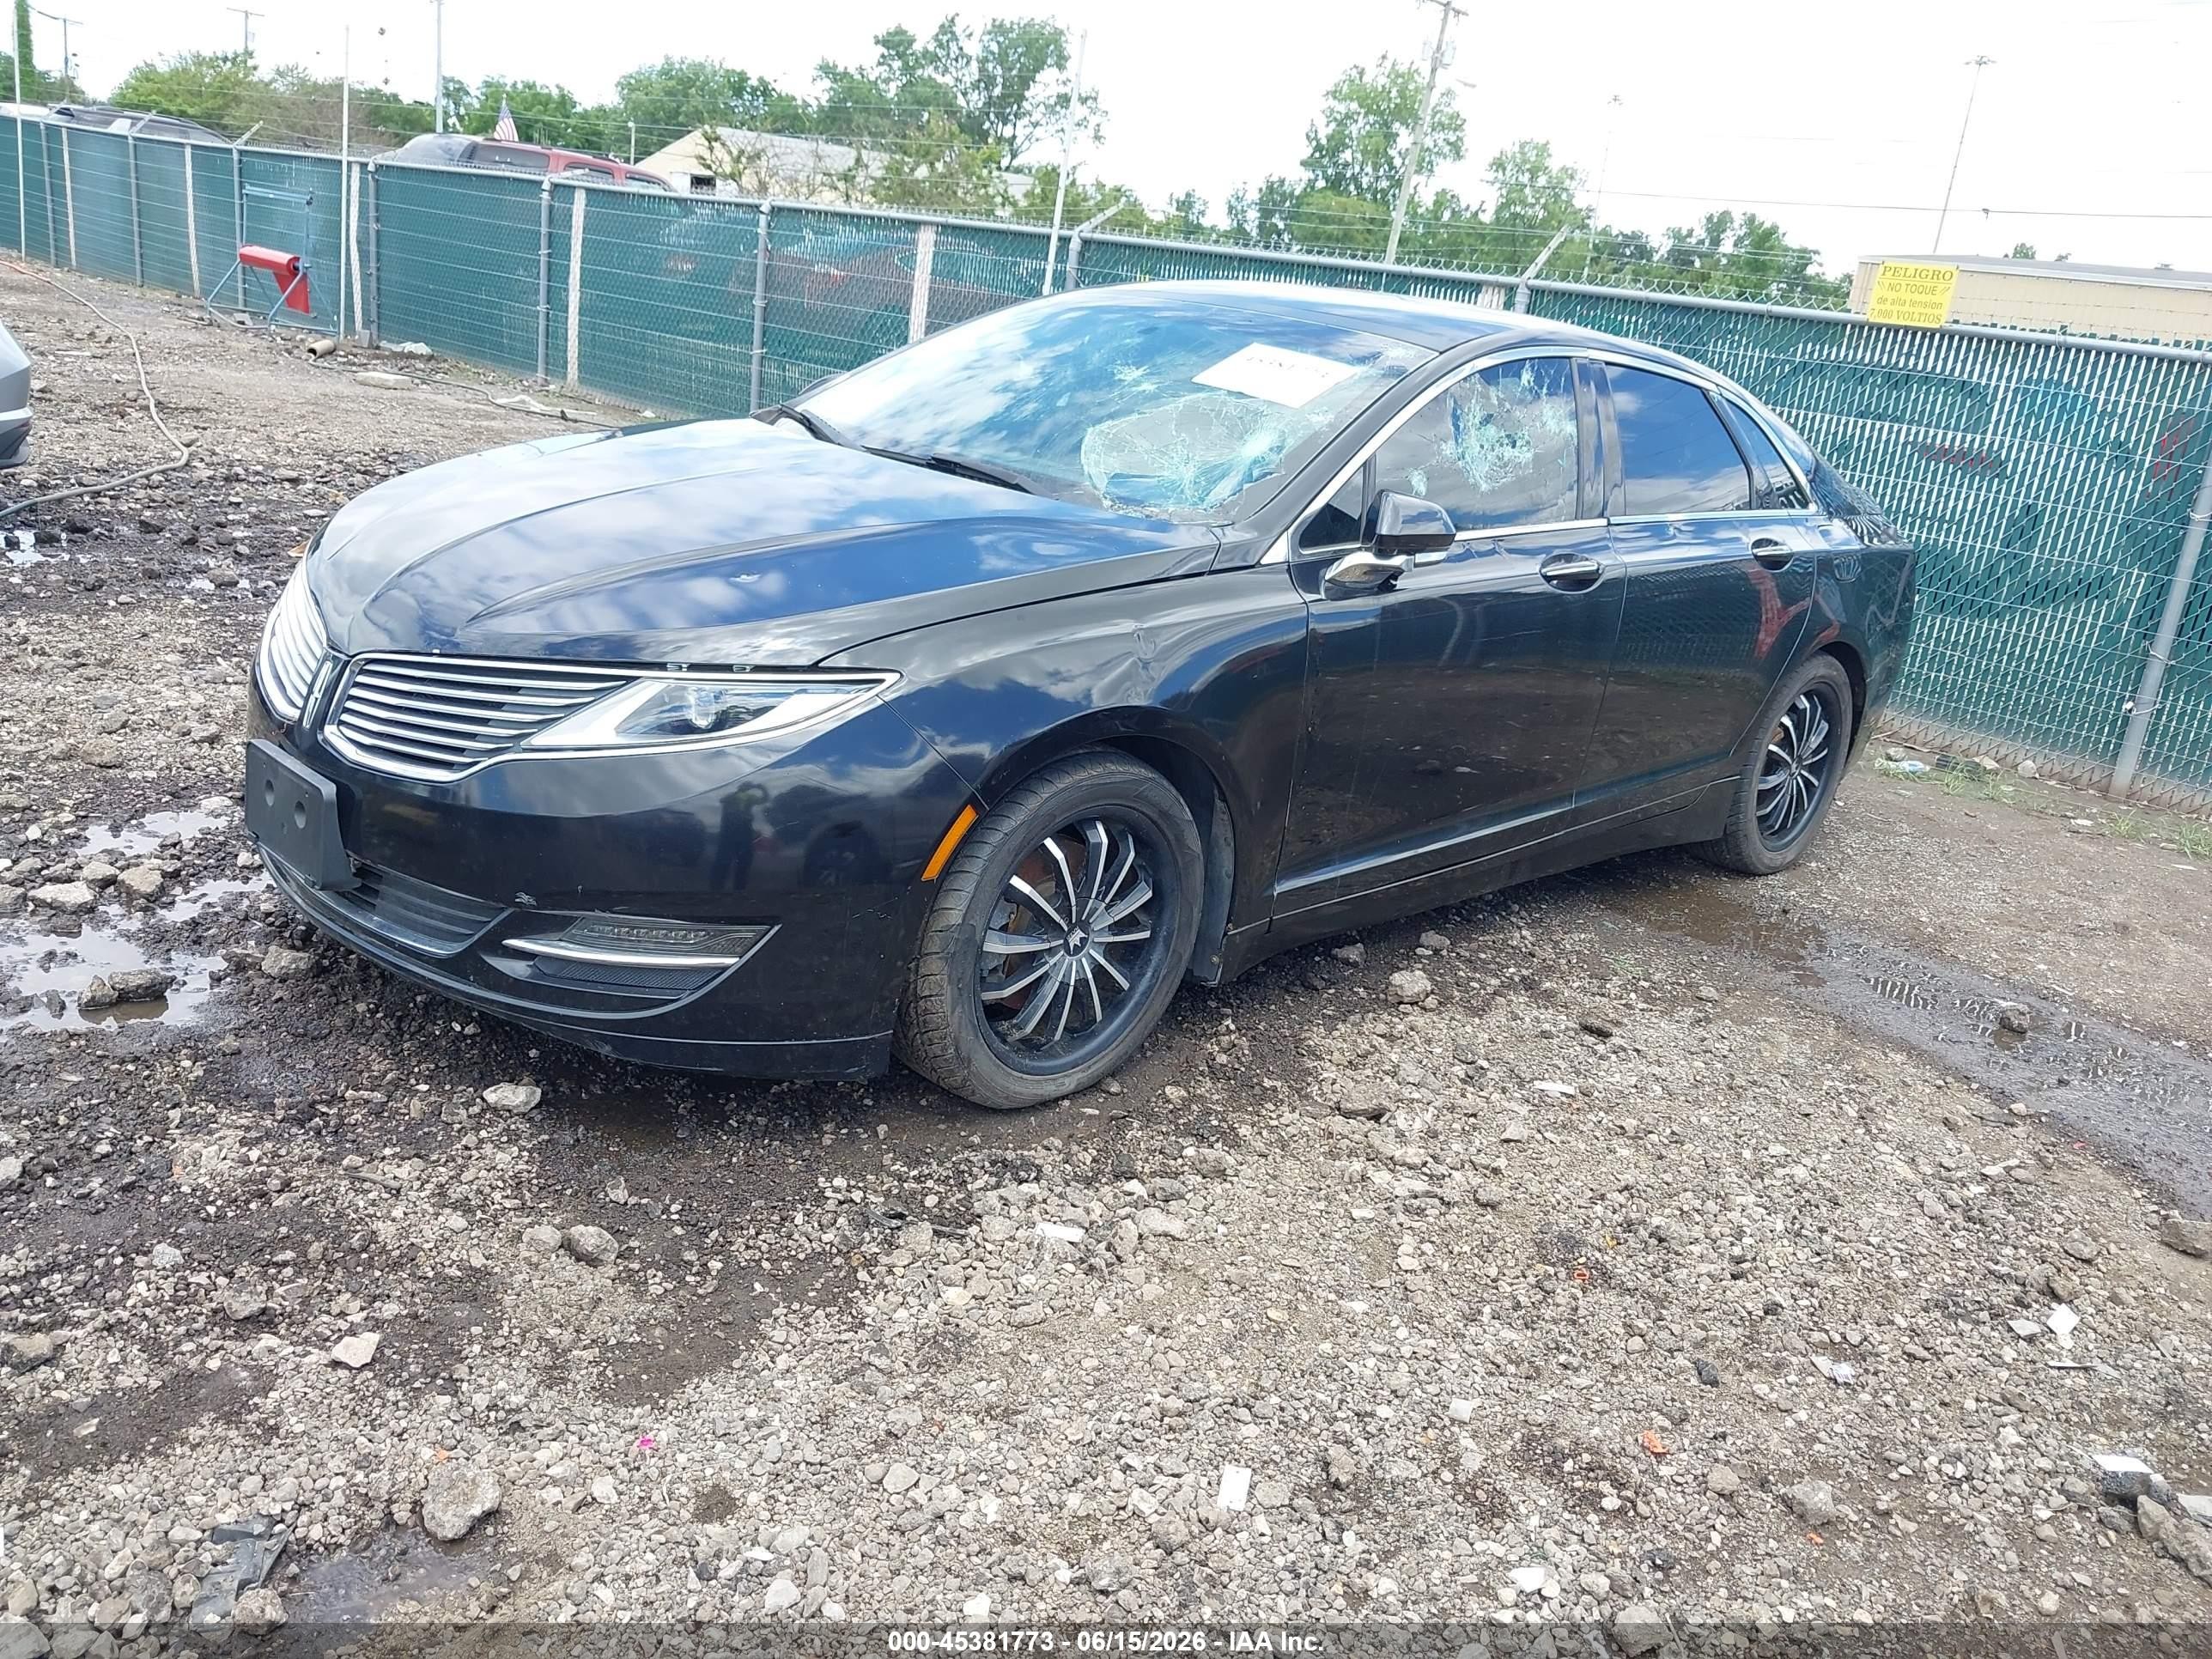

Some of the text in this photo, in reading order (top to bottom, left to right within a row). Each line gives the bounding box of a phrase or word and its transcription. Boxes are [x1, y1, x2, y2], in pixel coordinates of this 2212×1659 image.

[1881, 266, 1953, 282] PELIGRO
[1887, 283, 1937, 295] NO TOQUE
[1877, 295, 1942, 309] de alta tension
[1869, 308, 1942, 325] 7,000 VOLTIOS
